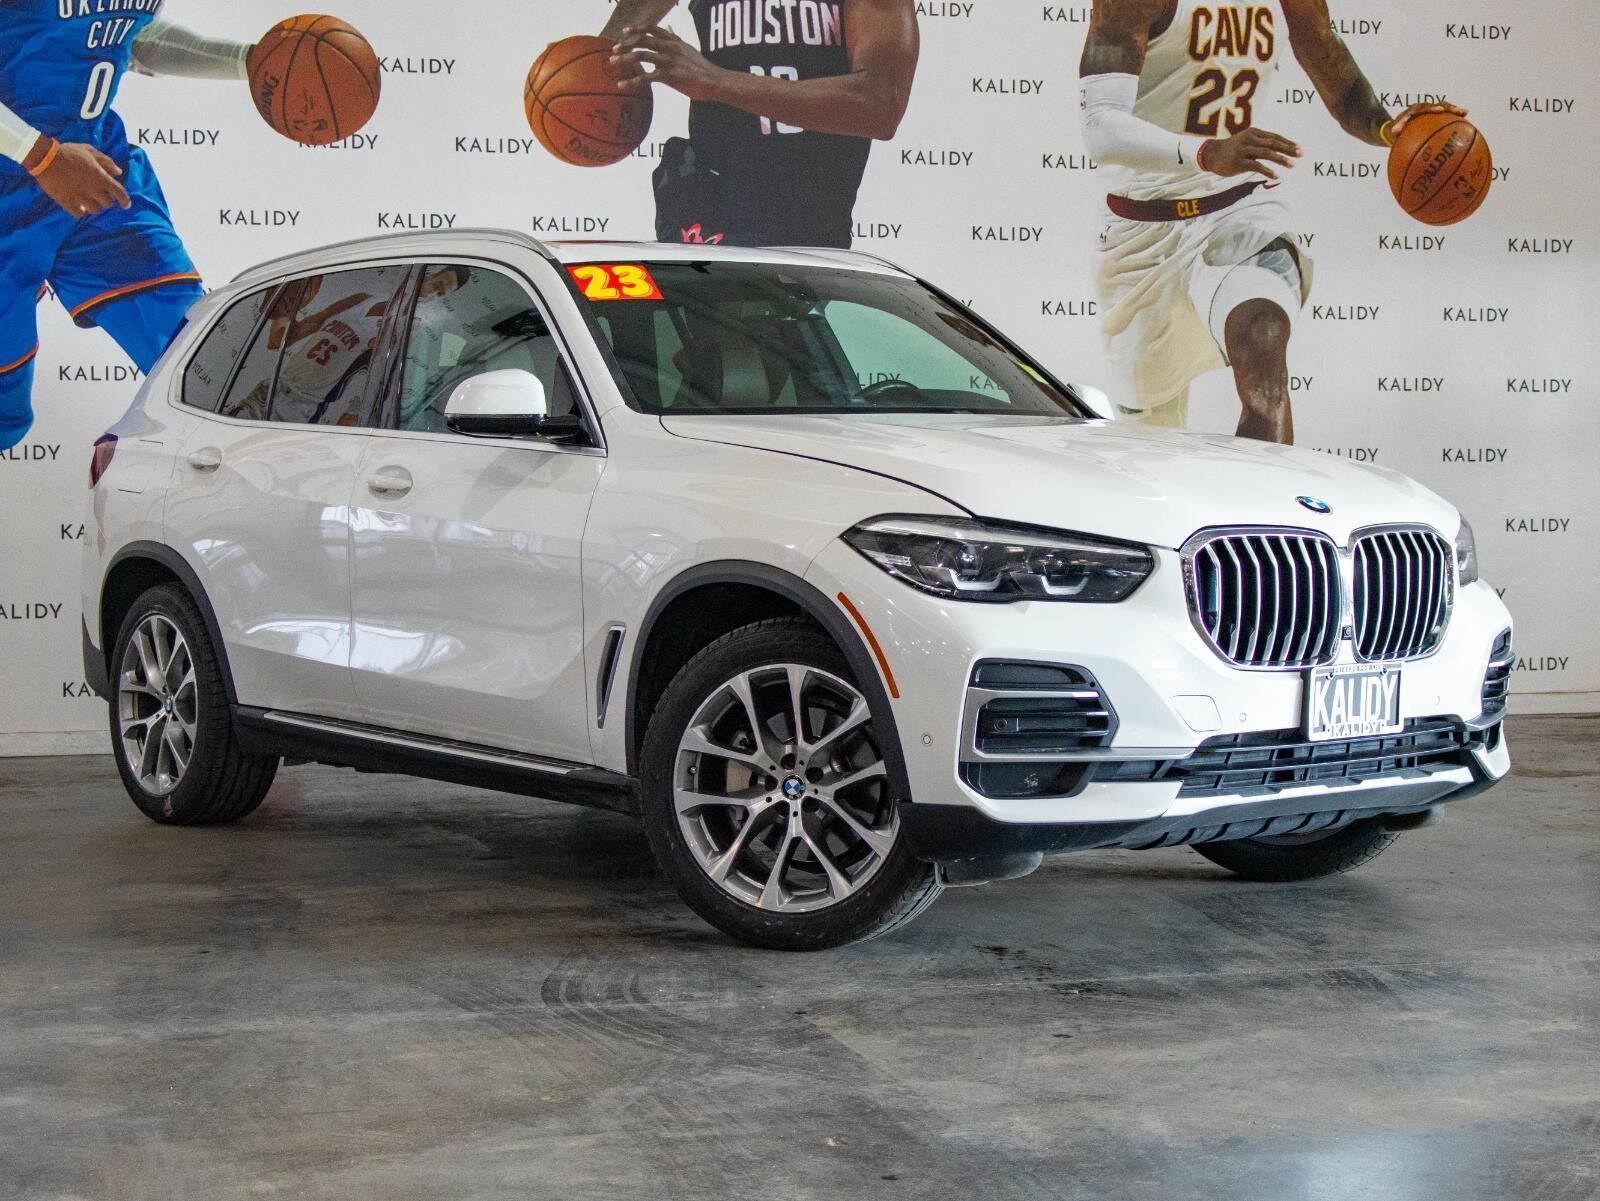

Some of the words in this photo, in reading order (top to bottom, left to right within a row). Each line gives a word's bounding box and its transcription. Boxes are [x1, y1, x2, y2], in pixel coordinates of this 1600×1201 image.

[915, 2, 974, 18] ALIDY
[1043, 7, 1093, 23] KALI
[87, 18, 135, 49] CITY
[709, 0, 841, 52] HOUSTON
[1330, 19, 1382, 35] ALIDY
[1446, 23, 1511, 40] KALIDY
[1187, 6, 1275, 63] CAVS
[378, 57, 456, 74] KALIDY
[80, 61, 115, 120] 0
[973, 78, 1044, 95] KALIDY
[1183, 67, 1260, 139] 23
[1509, 97, 1574, 113] KALIDY
[138, 128, 220, 146] KALIDY
[455, 136, 534, 154] KALIDY
[901, 150, 973, 166] KALIDY
[1314, 162, 1381, 178] KALIDY
[1176, 200, 1199, 217] CLE
[220, 209, 300, 226] KALIDY
[378, 212, 456, 229] KALIDY
[533, 216, 609, 233] KALIDY
[851, 223, 902, 239] LIDY
[972, 226, 1043, 242] KALIDY
[1379, 235, 1446, 250] KALIDY
[1508, 238, 1573, 254] KALIDY
[573, 265, 654, 299] 23
[1042, 301, 1096, 316] KALID
[1313, 305, 1380, 320] KALIDY
[1443, 307, 1509, 322] KALIDY
[59, 365, 141, 381] KALIDY
[1378, 377, 1444, 392] KALIDY
[1507, 378, 1572, 393] KALIDY
[1442, 448, 1508, 463] KALIDY
[1505, 518, 1570, 532] KALIDY
[0, 603, 62, 619] ALIDY
[1313, 674, 1398, 728] KALIDY
